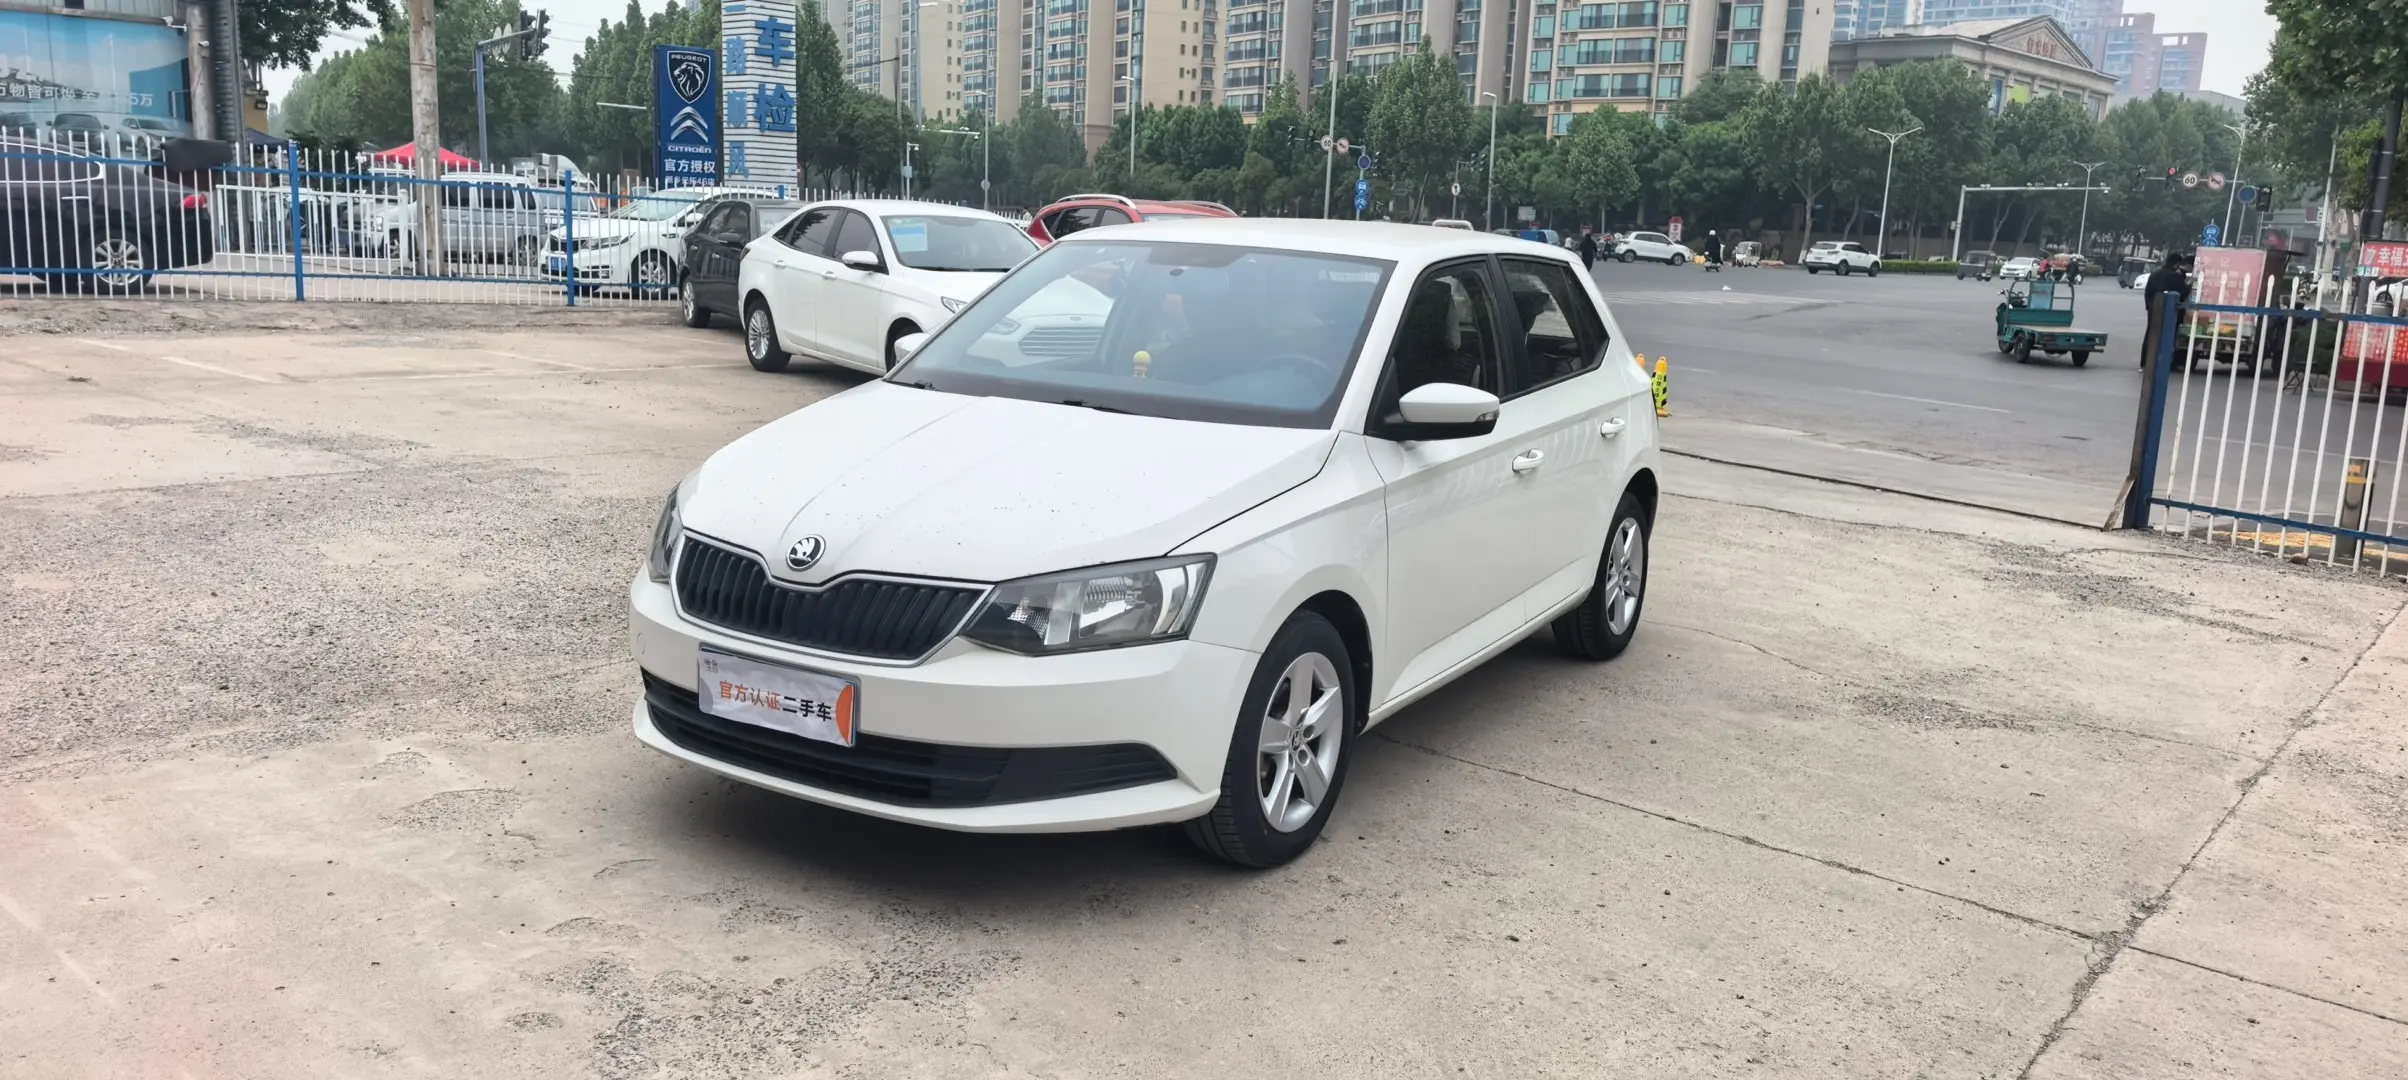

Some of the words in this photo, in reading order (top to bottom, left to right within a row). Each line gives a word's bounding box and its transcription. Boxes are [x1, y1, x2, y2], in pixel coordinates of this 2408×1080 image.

[671, 54, 707, 62] PEUGEOT
[754, 17, 797, 133] 车检
[664, 158, 716, 173] 官方授权
[2184, 176, 2196, 184] 60
[719, 680, 832, 722] 官方认证二手车
